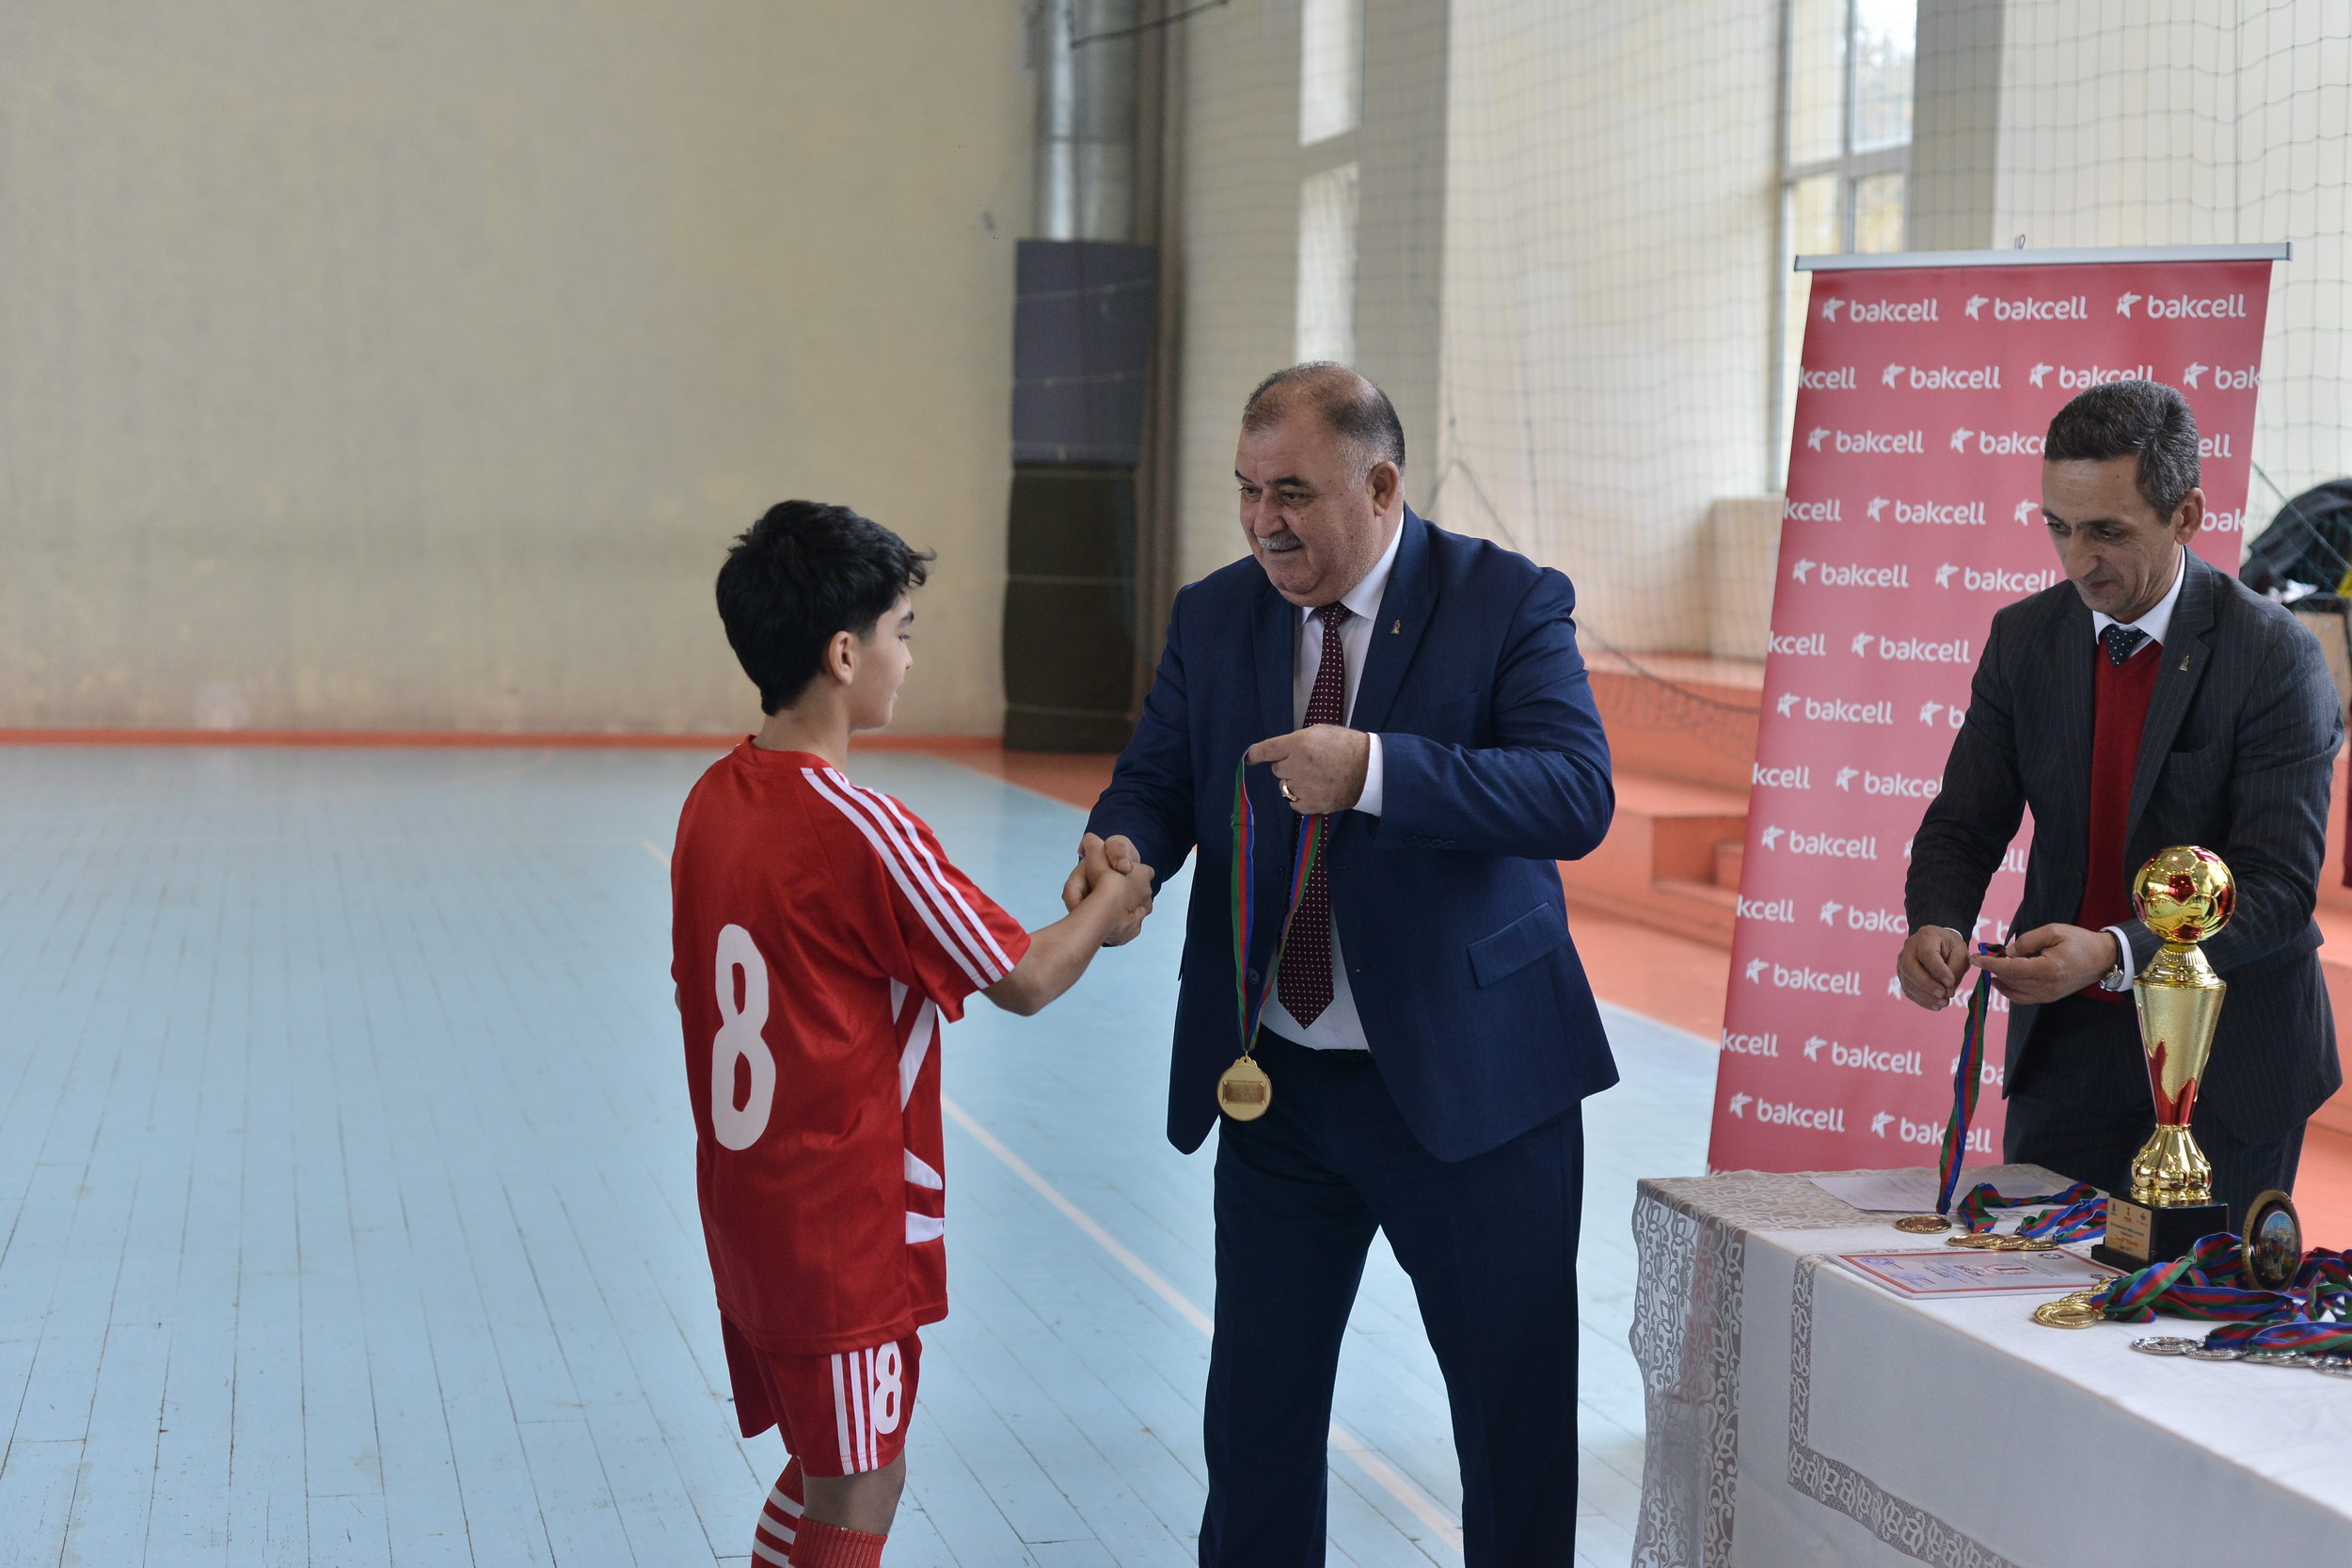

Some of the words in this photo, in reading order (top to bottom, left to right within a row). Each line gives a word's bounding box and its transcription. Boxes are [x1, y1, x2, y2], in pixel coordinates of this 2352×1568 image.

[1850, 298, 1939, 324] bakcell
[1994, 295, 2089, 321] bakcell
[2147, 293, 2247, 320] bakcell
[1910, 365, 2001, 390] bakcell
[1836, 429, 1925, 454] bakcell
[1979, 430, 2047, 455] bakc
[1895, 499, 1987, 526] bakcell
[1820, 562, 1910, 588] bakcell
[1964, 566, 2057, 593] bakcell
[1879, 636, 1971, 663] bakcell
[1804, 697, 1894, 724] bakcell
[1864, 770, 1944, 799] bakce
[1788, 830, 1879, 861] bakcell
[1848, 906, 1909, 934] bakc
[1772, 963, 1863, 997] bakcell
[711, 923, 777, 1150] 8
[1831, 1041, 1923, 1077] bakcell
[1756, 1098, 1846, 1133] bakcell
[1899, 1117, 1993, 1154] bakell
[874, 1340, 902, 1434] 8
